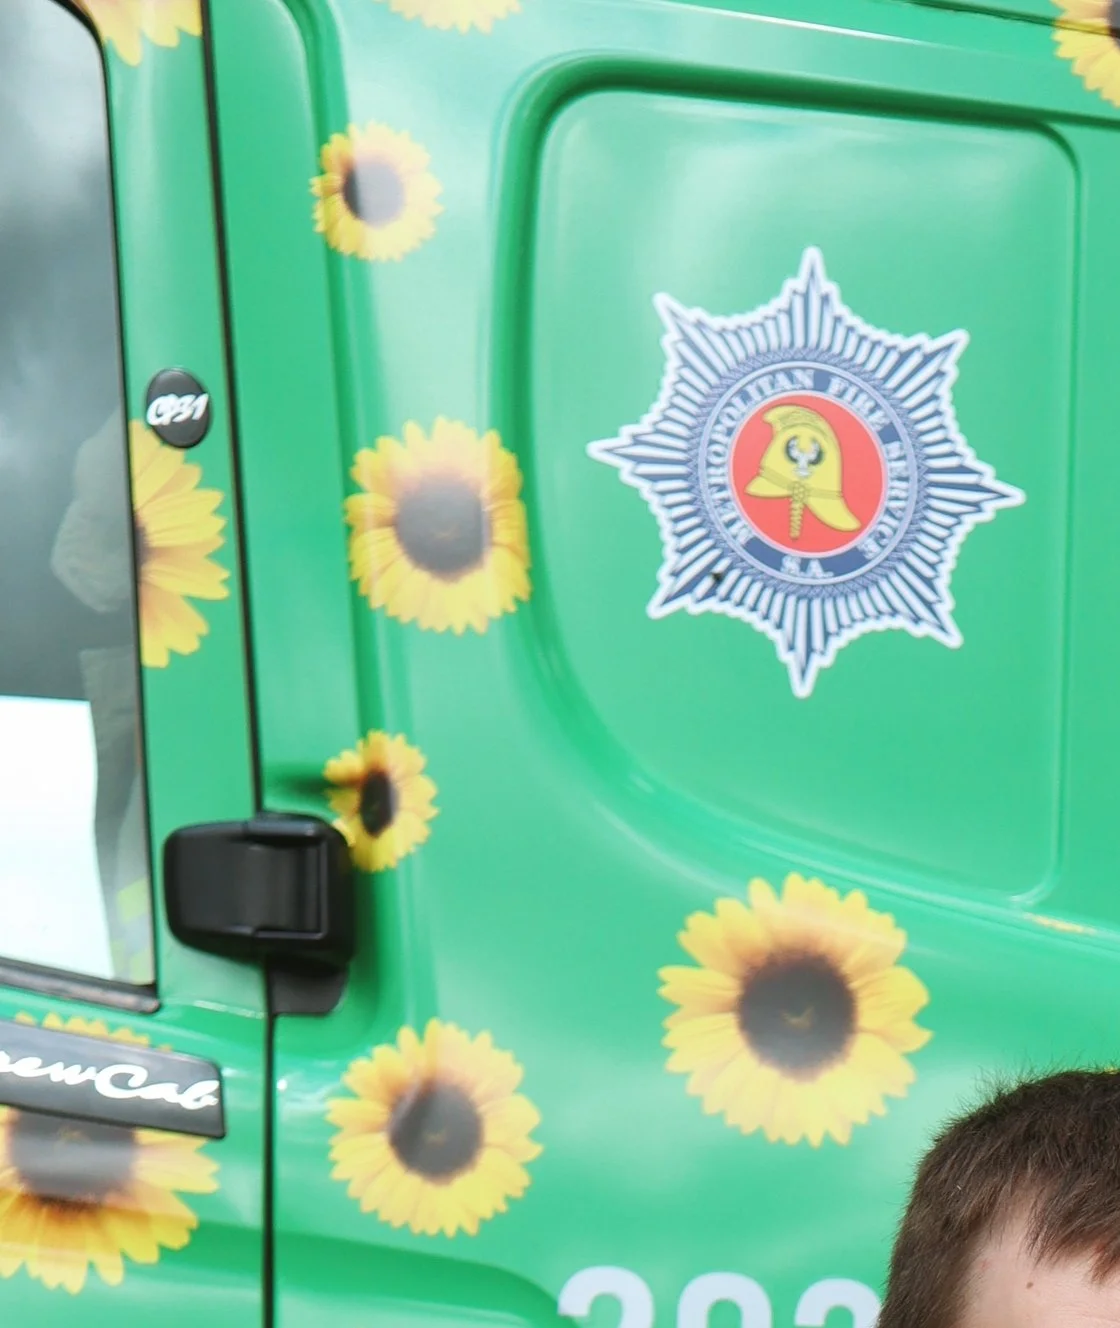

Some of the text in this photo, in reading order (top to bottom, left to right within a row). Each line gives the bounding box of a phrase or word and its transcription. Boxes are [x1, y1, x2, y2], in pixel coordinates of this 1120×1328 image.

[706, 369, 908, 560] METROPOLITAN FIRE SERVICE
